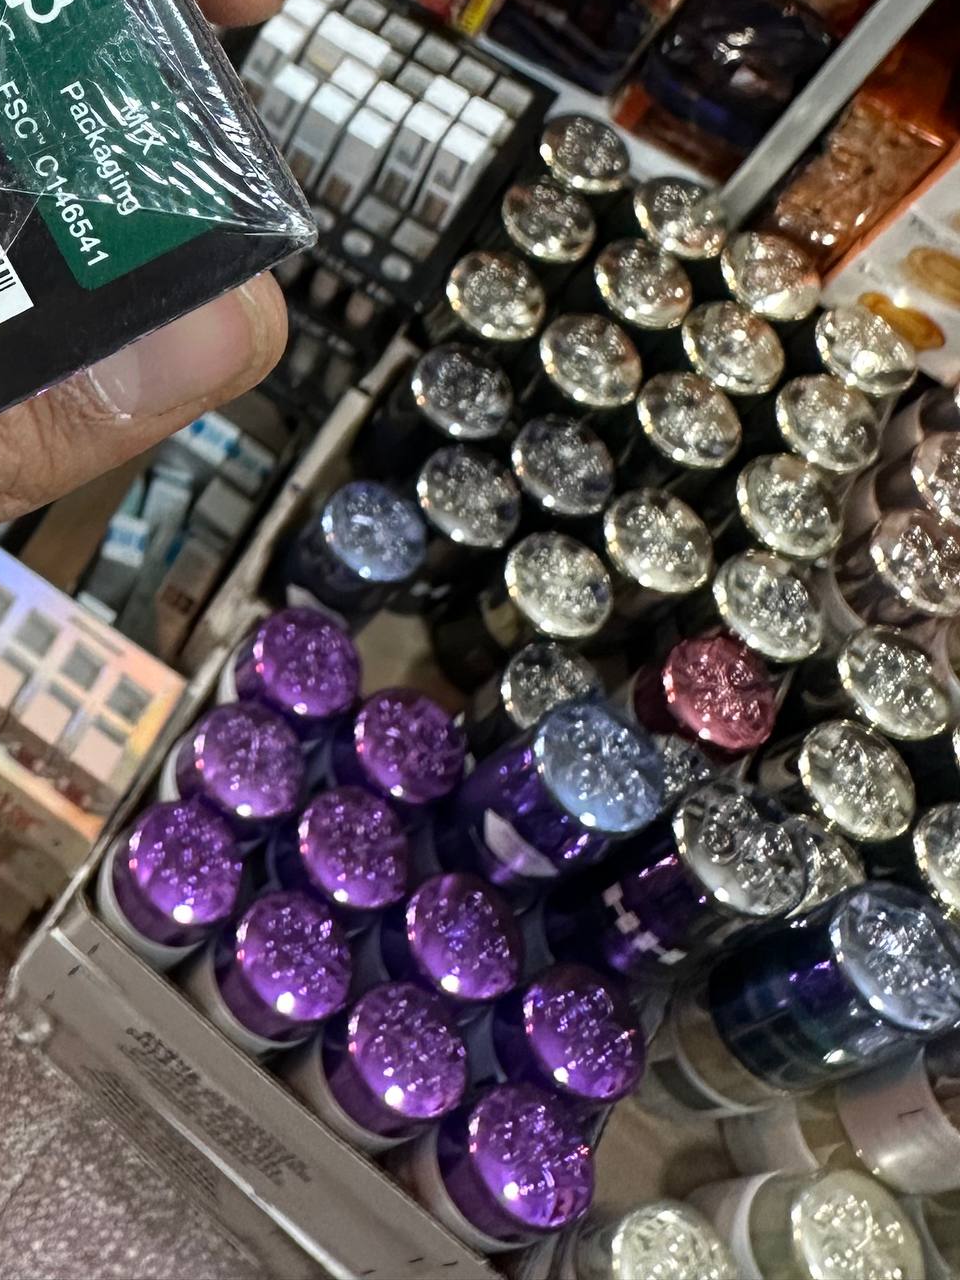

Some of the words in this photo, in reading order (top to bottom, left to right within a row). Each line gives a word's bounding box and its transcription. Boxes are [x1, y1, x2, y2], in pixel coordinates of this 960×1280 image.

[59, 81, 140, 216] Packaging
[120, 103, 165, 156] MIX
[34, 155, 110, 267] C146541
